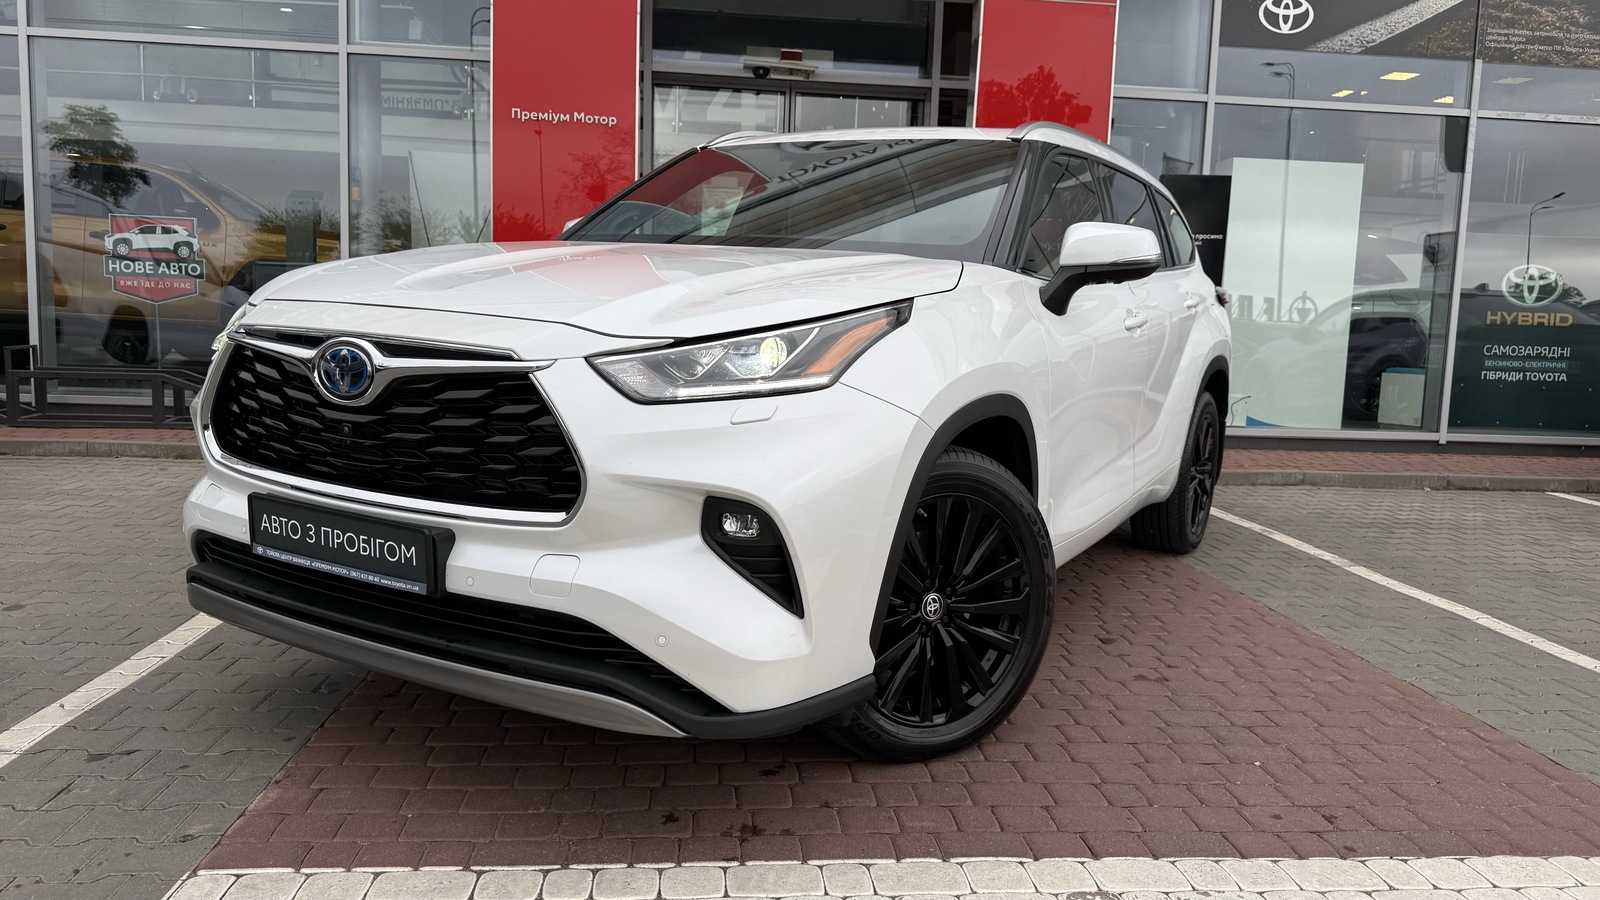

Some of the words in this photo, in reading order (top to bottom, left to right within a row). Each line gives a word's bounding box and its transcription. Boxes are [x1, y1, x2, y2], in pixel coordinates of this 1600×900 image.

[511, 107, 570, 124] Преміум
[573, 111, 617, 128] Мотор
[1195, 233, 1224, 241] просимо
[108, 259, 154, 274] НОВЕ
[158, 262, 201, 276] АВТО
[158, 281, 171, 289] ДО
[1486, 311, 1573, 327] HYBRID
[1483, 344, 1571, 359] САМОЗАРЯДНІ
[1485, 360, 1567, 369] БЕНЗИНОВО-ЕЛЕКТРИЧНІ
[1481, 371, 1523, 382] ГІБРИДИ
[1525, 371, 1567, 382] TOYOTA
[260, 513, 301, 540] АВТО
[306, 523, 316, 543] З
[320, 526, 416, 566] ПРОБІГОМ
